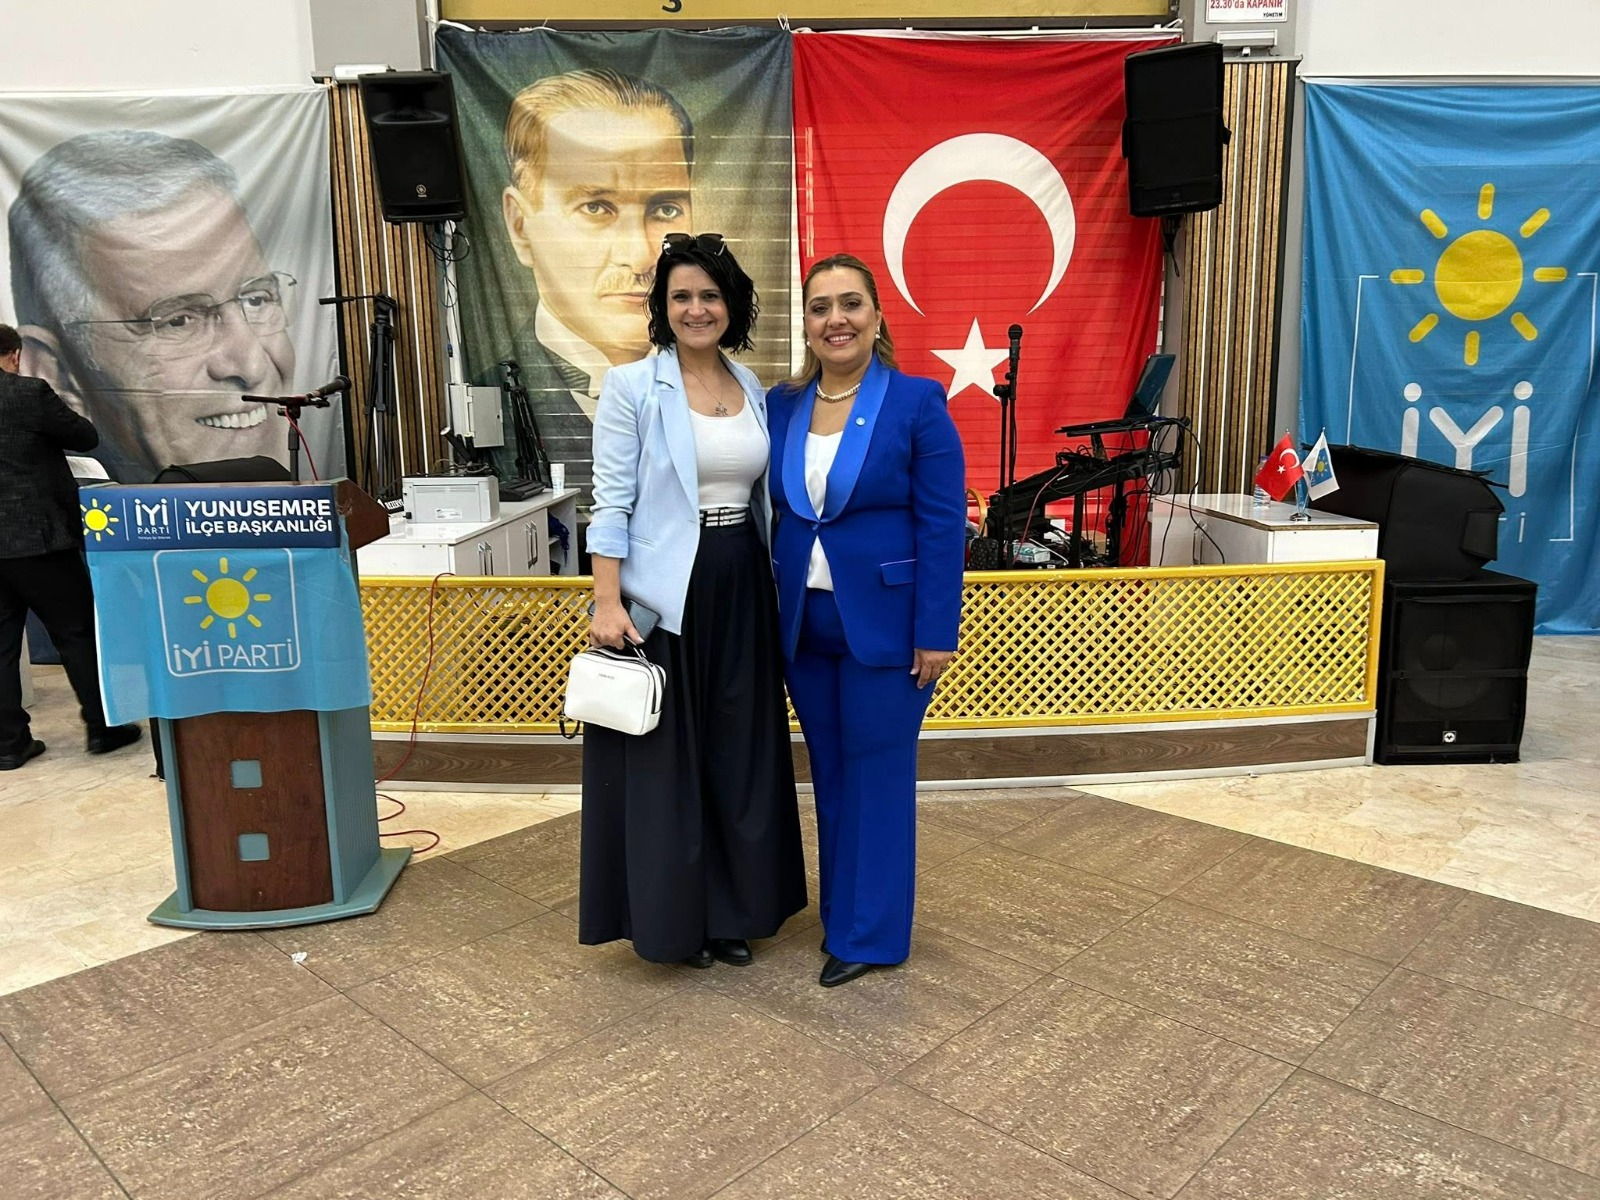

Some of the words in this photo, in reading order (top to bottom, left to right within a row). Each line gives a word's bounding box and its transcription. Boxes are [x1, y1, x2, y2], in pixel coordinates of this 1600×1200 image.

[1247, 0, 1283, 9] KAPANIR
[1400, 380, 1534, 498] İYİ
[134, 498, 169, 527] İYİ
[185, 499, 332, 518] YUNUSEMRE
[185, 518, 225, 537] İLÇE
[227, 516, 333, 537] BAŞKANLIĞI
[173, 640, 212, 671] İYİ
[217, 638, 294, 667] PARTİ
